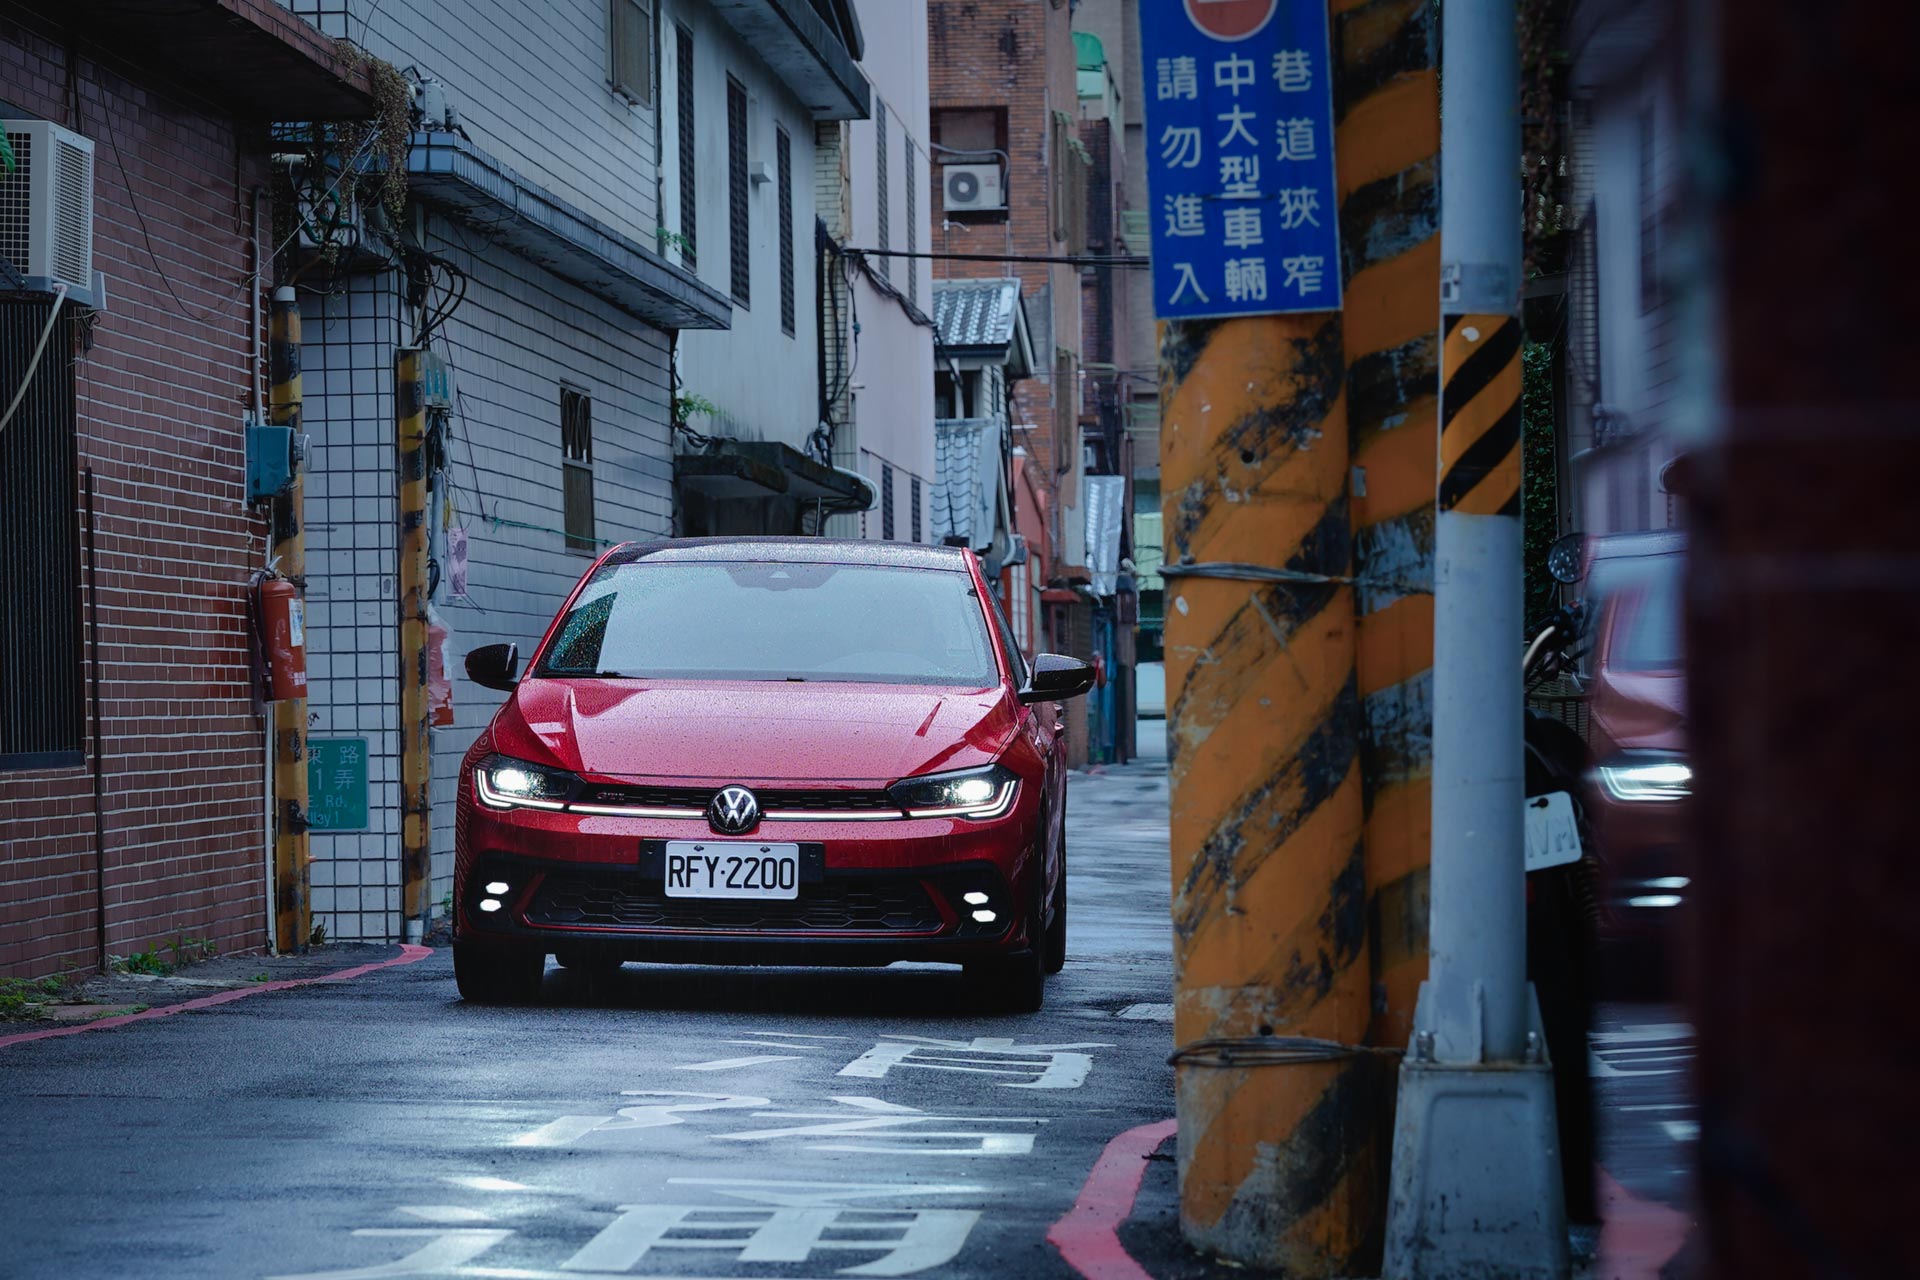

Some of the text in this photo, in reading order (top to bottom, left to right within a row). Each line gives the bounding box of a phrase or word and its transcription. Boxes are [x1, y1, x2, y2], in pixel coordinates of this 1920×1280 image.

[1156, 56, 1210, 305] 請勿進入
[1213, 53, 1268, 302] 中大型車輛
[1272, 49, 1324, 297] 巷道狹窄
[309, 811, 331, 828] lley
[326, 794, 347, 808] Rd.
